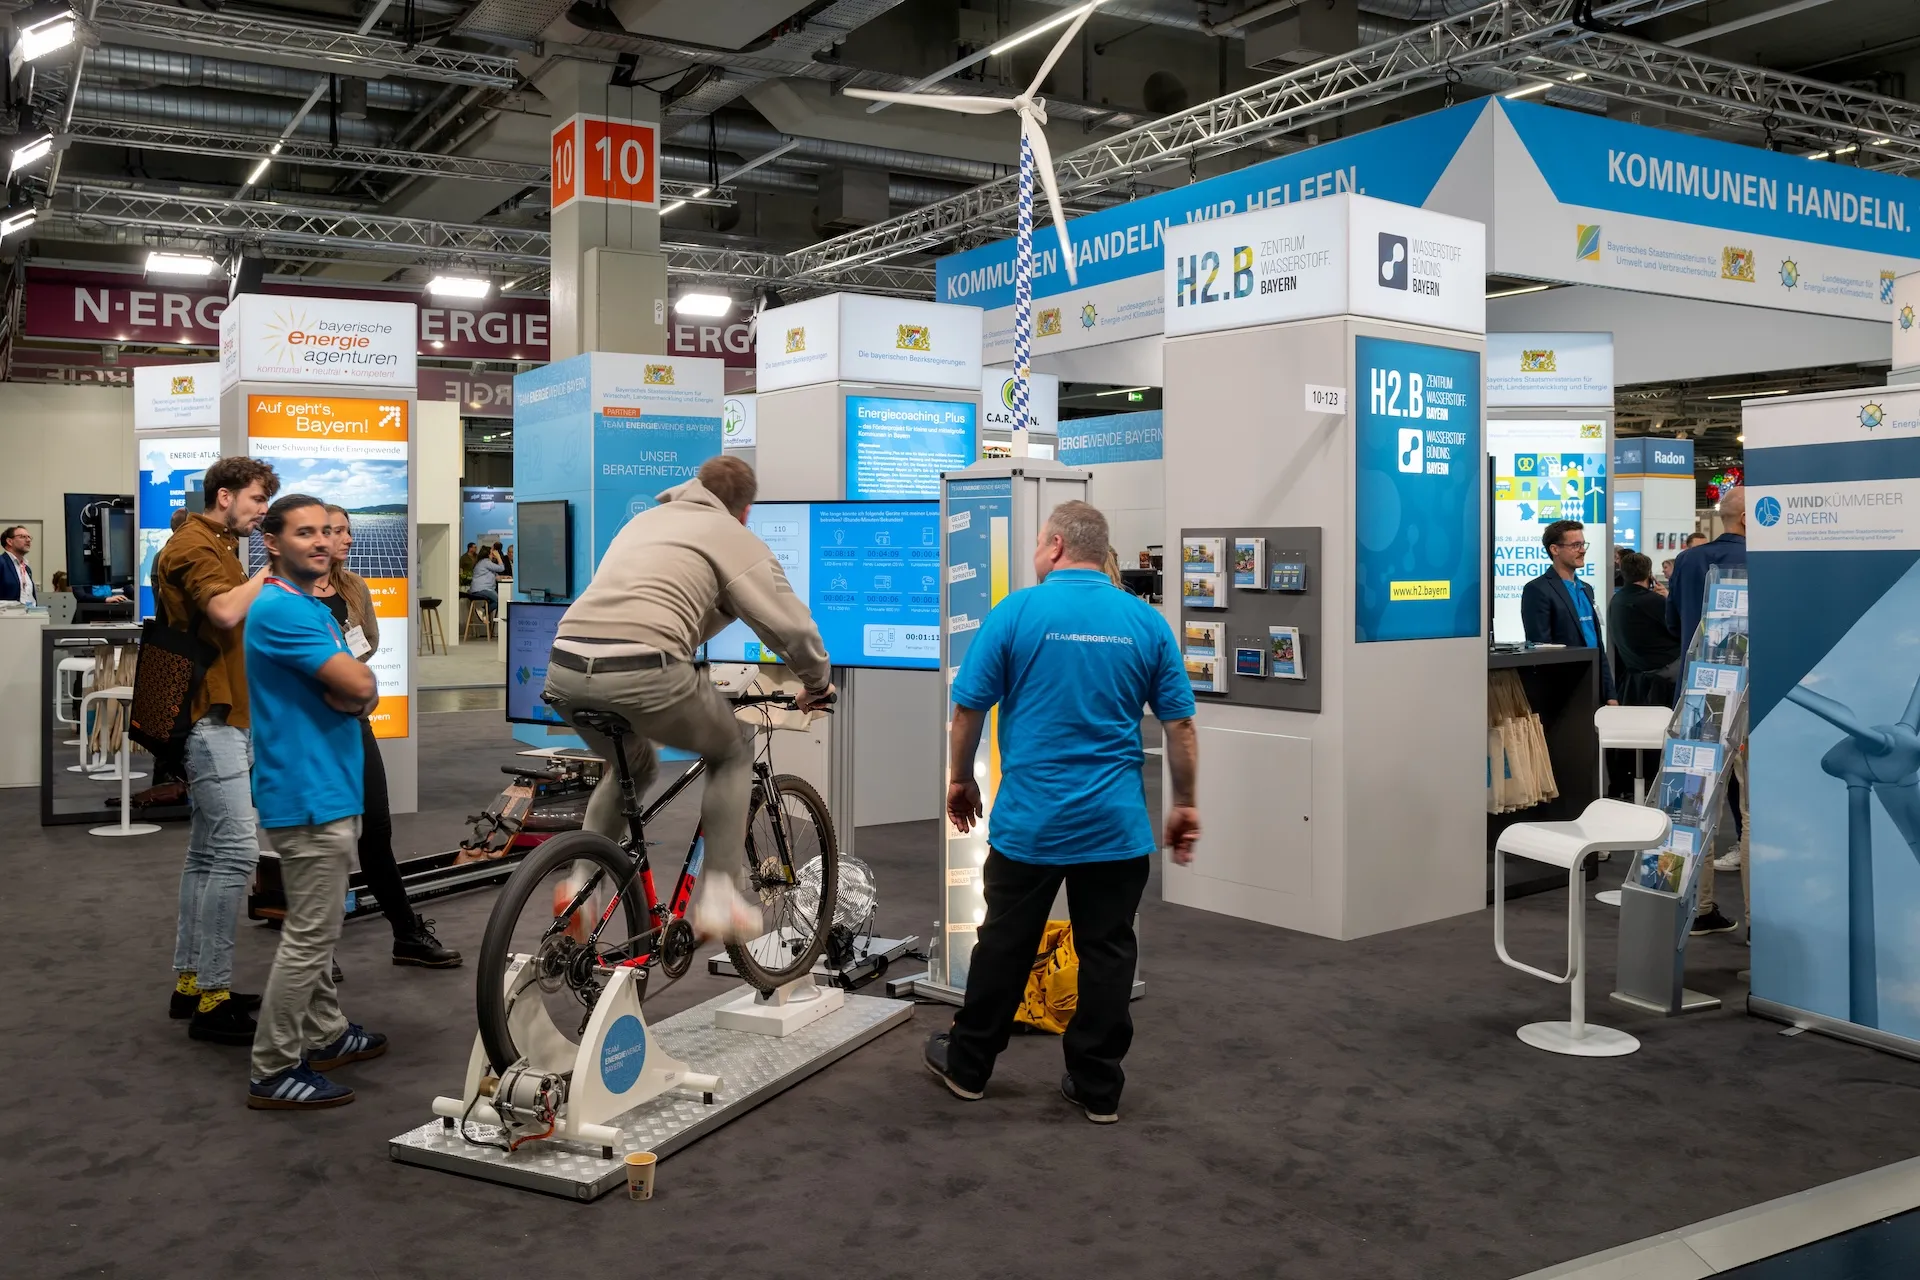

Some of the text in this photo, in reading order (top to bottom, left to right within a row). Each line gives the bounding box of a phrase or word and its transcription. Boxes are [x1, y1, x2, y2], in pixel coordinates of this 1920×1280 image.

[556, 139, 572, 190] 10
[595, 136, 645, 185] 10
[1608, 149, 1911, 233] KOMMUNEN HANDELN.
[1261, 235, 1305, 257] ZENTRUM
[1411, 238, 1461, 262] WASSERSTOFF
[1607, 241, 1717, 266] Bayerisches Staatsministerium für
[1261, 250, 1331, 275] WASSERSTOFF.
[1616, 255, 1717, 279] Umwelt und Verbraucherschutz
[947, 248, 1057, 300] KOMMUEN
[1177, 245, 1254, 308] H2.B
[1822, 273, 1873, 288] Landesagentur für
[1260, 276, 1297, 295] BAYERN
[1412, 278, 1440, 296] BAYERN
[1803, 282, 1873, 300] Energie und Klimaschutz
[1116, 299, 1155, 313] Landesagentur
[319, 320, 392, 334] bayerische
[421, 308, 548, 346] ERGIE
[1100, 315, 1122, 326] Energie
[1122, 313, 1132, 323] und
[287, 330, 370, 350] energie
[304, 350, 398, 366] agenturen
[858, 350, 967, 367] Die bayerischen Bezirksregierungen
[257, 365, 396, 378] kommunal neutral kompetent
[1426, 374, 1453, 390] ZENTRUM
[615, 387, 647, 395] Bayerisches
[1312, 390, 1338, 405] 10-123
[1371, 368, 1423, 418] H2.B
[1426, 390, 1467, 407] WASSERSTOFF.
[256, 401, 282, 414] Auf
[607, 408, 637, 416] PARTNER
[1426, 407, 1449, 421] BAYERN
[858, 407, 966, 424] Energiecoaching_Plus
[296, 416, 368, 436] Bayern!
[603, 421, 624, 429] TEAM
[686, 424, 714, 432] BAYERN
[1892, 419, 1920, 429] Energi
[1125, 428, 1163, 444] BAYERN
[1426, 430, 1466, 445] WASSERSTOFF
[256, 443, 280, 451] Neuer
[282, 444, 319, 452] Schwung
[346, 446, 401, 455] Energiewende
[640, 451, 678, 462] UNSER
[1654, 450, 1685, 465] Radon
[1426, 461, 1449, 475] BAYERN
[1787, 492, 1903, 509] WINDKÜMMERER
[951, 513, 970, 523] GELBES
[1787, 512, 1838, 525] BAYERN
[951, 521, 969, 531] TRIKOT
[951, 564, 968, 574] SUPER
[952, 571, 976, 581] SPRINTER
[1393, 585, 1448, 597] www.h2.bayern
[952, 620, 979, 632] SPEZIALIST
[1046, 632, 1134, 645] #TEAMENERGIEWENDE
[605, 1044, 620, 1055] TEAM
[605, 1043, 642, 1066] ENERGIEWENDE
[605, 1061, 624, 1075] BAYERN
